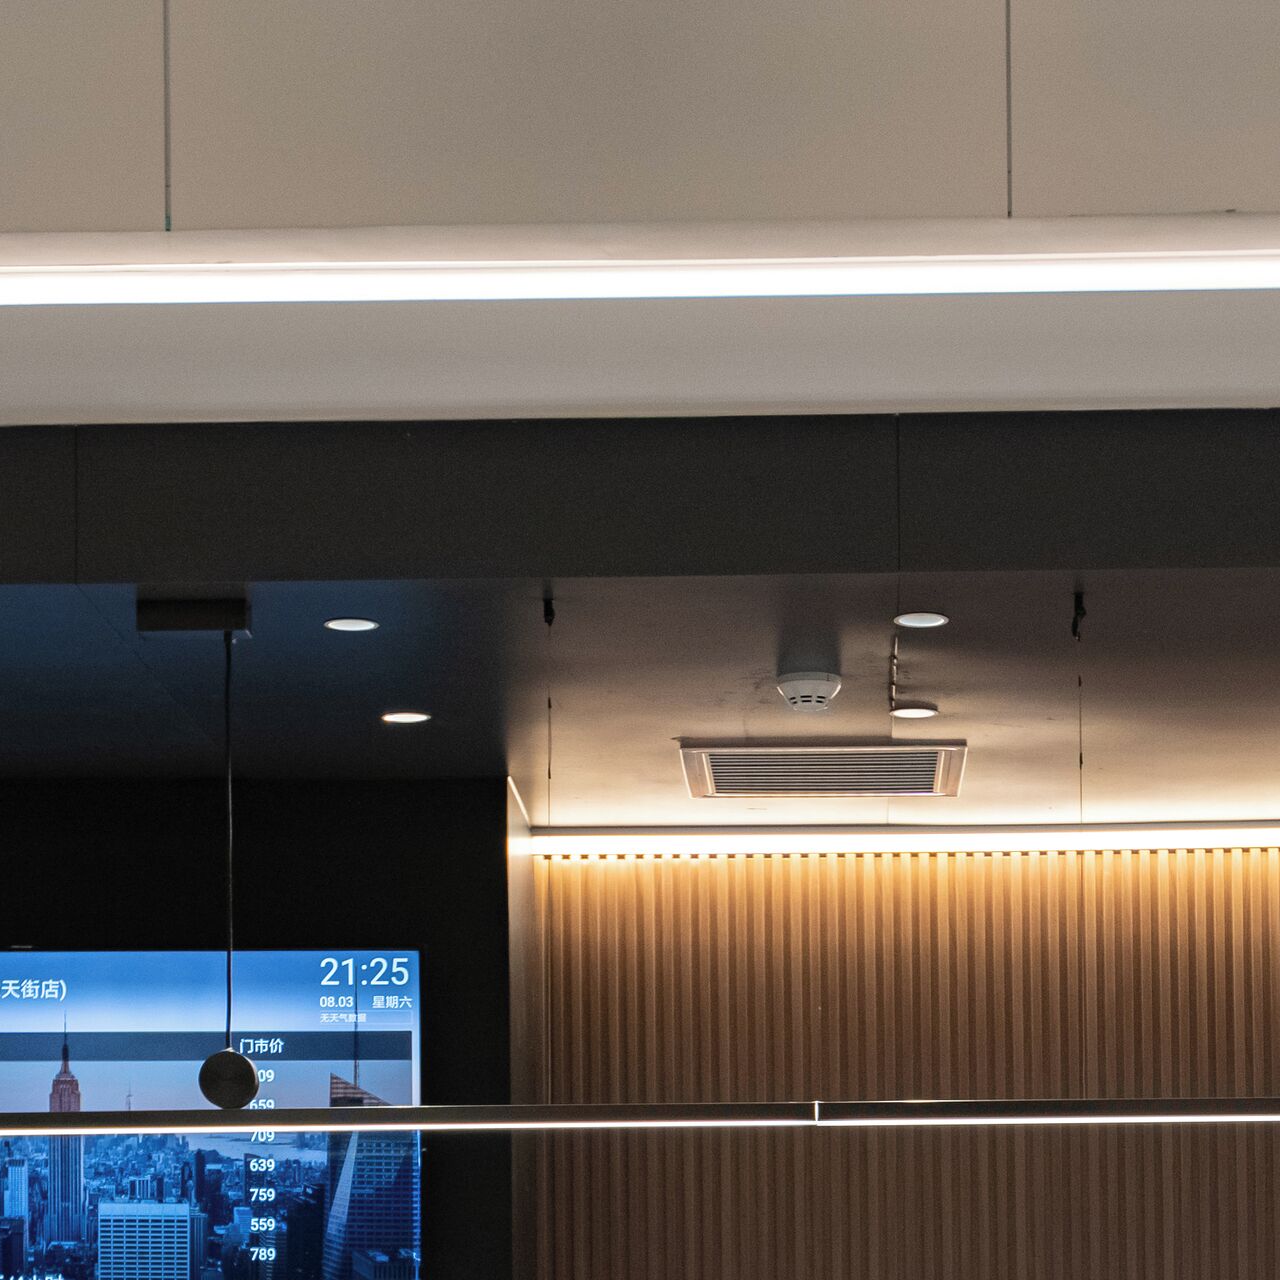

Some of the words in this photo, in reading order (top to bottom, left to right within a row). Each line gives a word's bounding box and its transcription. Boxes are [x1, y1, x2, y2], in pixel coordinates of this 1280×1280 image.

[319, 957, 410, 986] 21:25
[319, 996, 354, 1008] 08.03
[371, 995, 413, 1009] 星期六
[239, 1038, 285, 1054] 门市价
[256, 1069, 275, 1083] 09
[249, 1158, 275, 1172] 639
[249, 1188, 276, 1201] 759
[250, 1218, 276, 1231] 559
[249, 1248, 276, 1261] 789
